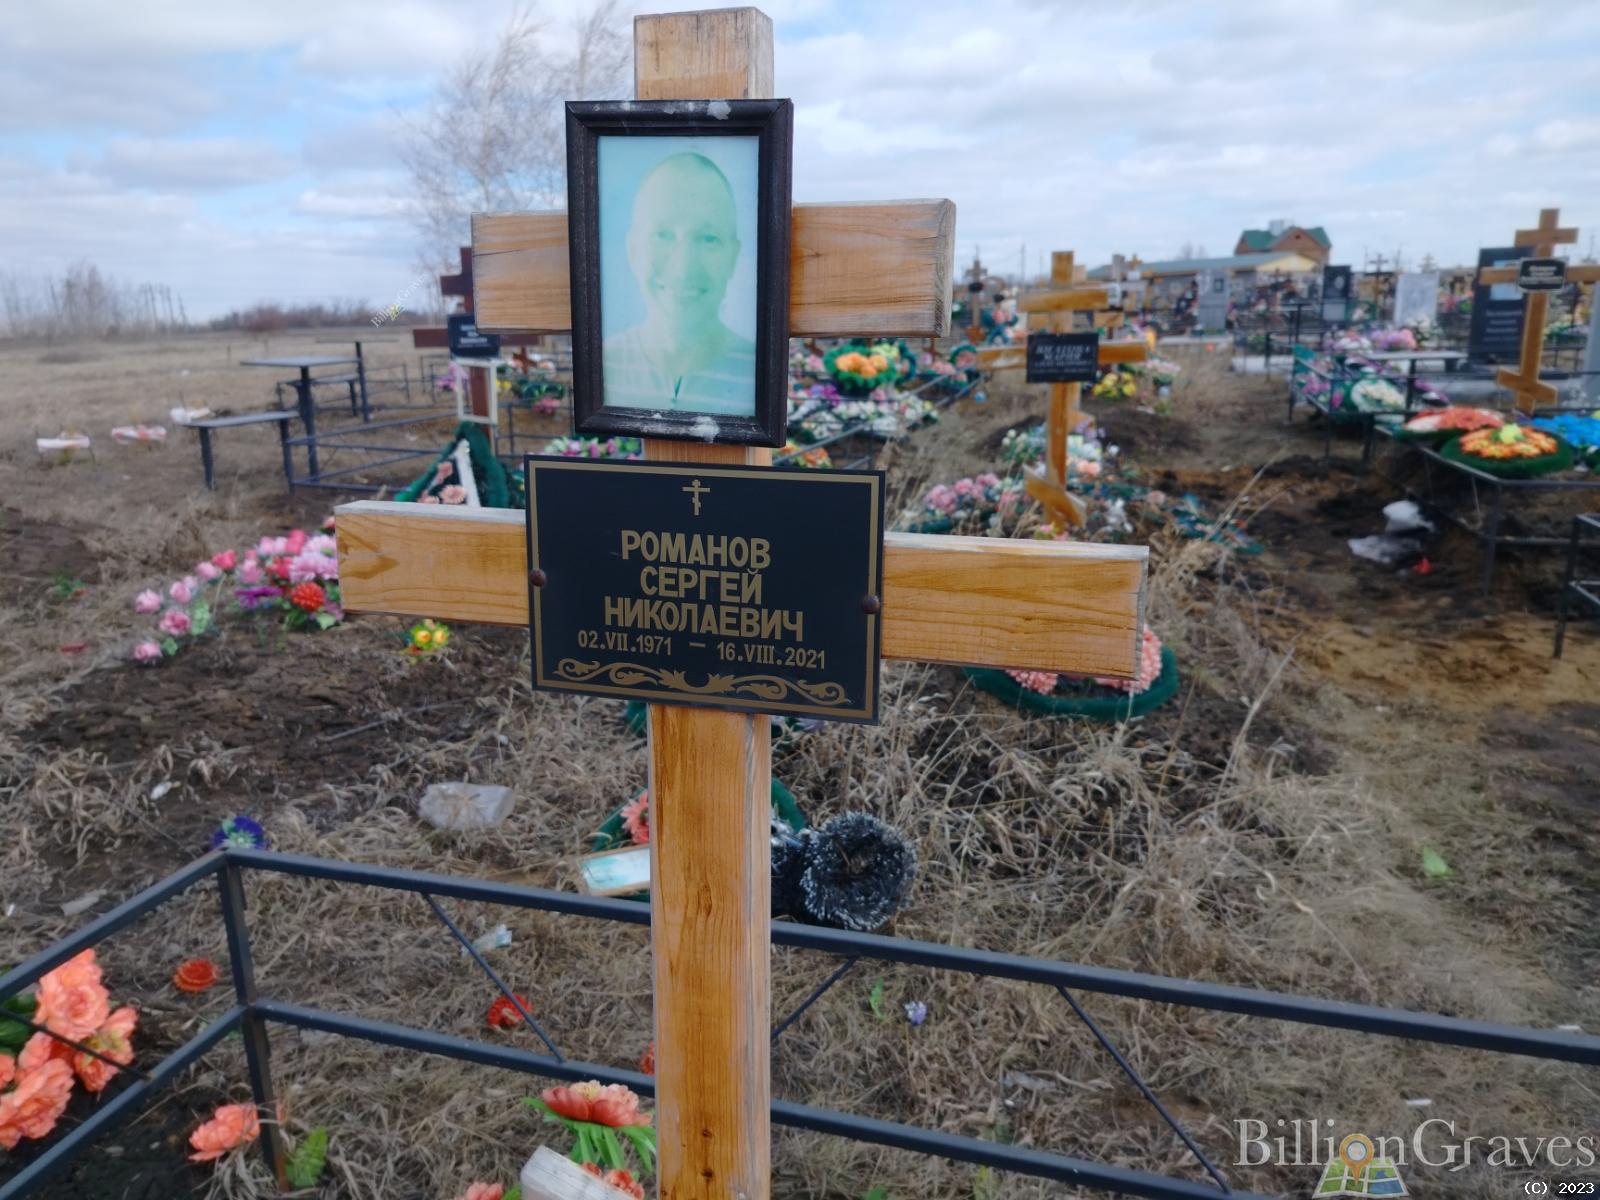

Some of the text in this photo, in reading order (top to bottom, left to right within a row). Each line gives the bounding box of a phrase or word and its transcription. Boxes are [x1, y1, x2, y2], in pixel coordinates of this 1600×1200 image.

[620, 529, 771, 569] РОМАНОВ
[640, 566, 763, 605] СЕРГЕЙ
[604, 596, 804, 642] НИКОЛАЕВИЧ
[577, 631, 672, 656] 02.VII.1971
[717, 642, 826, 670] 16.VIII.2021
